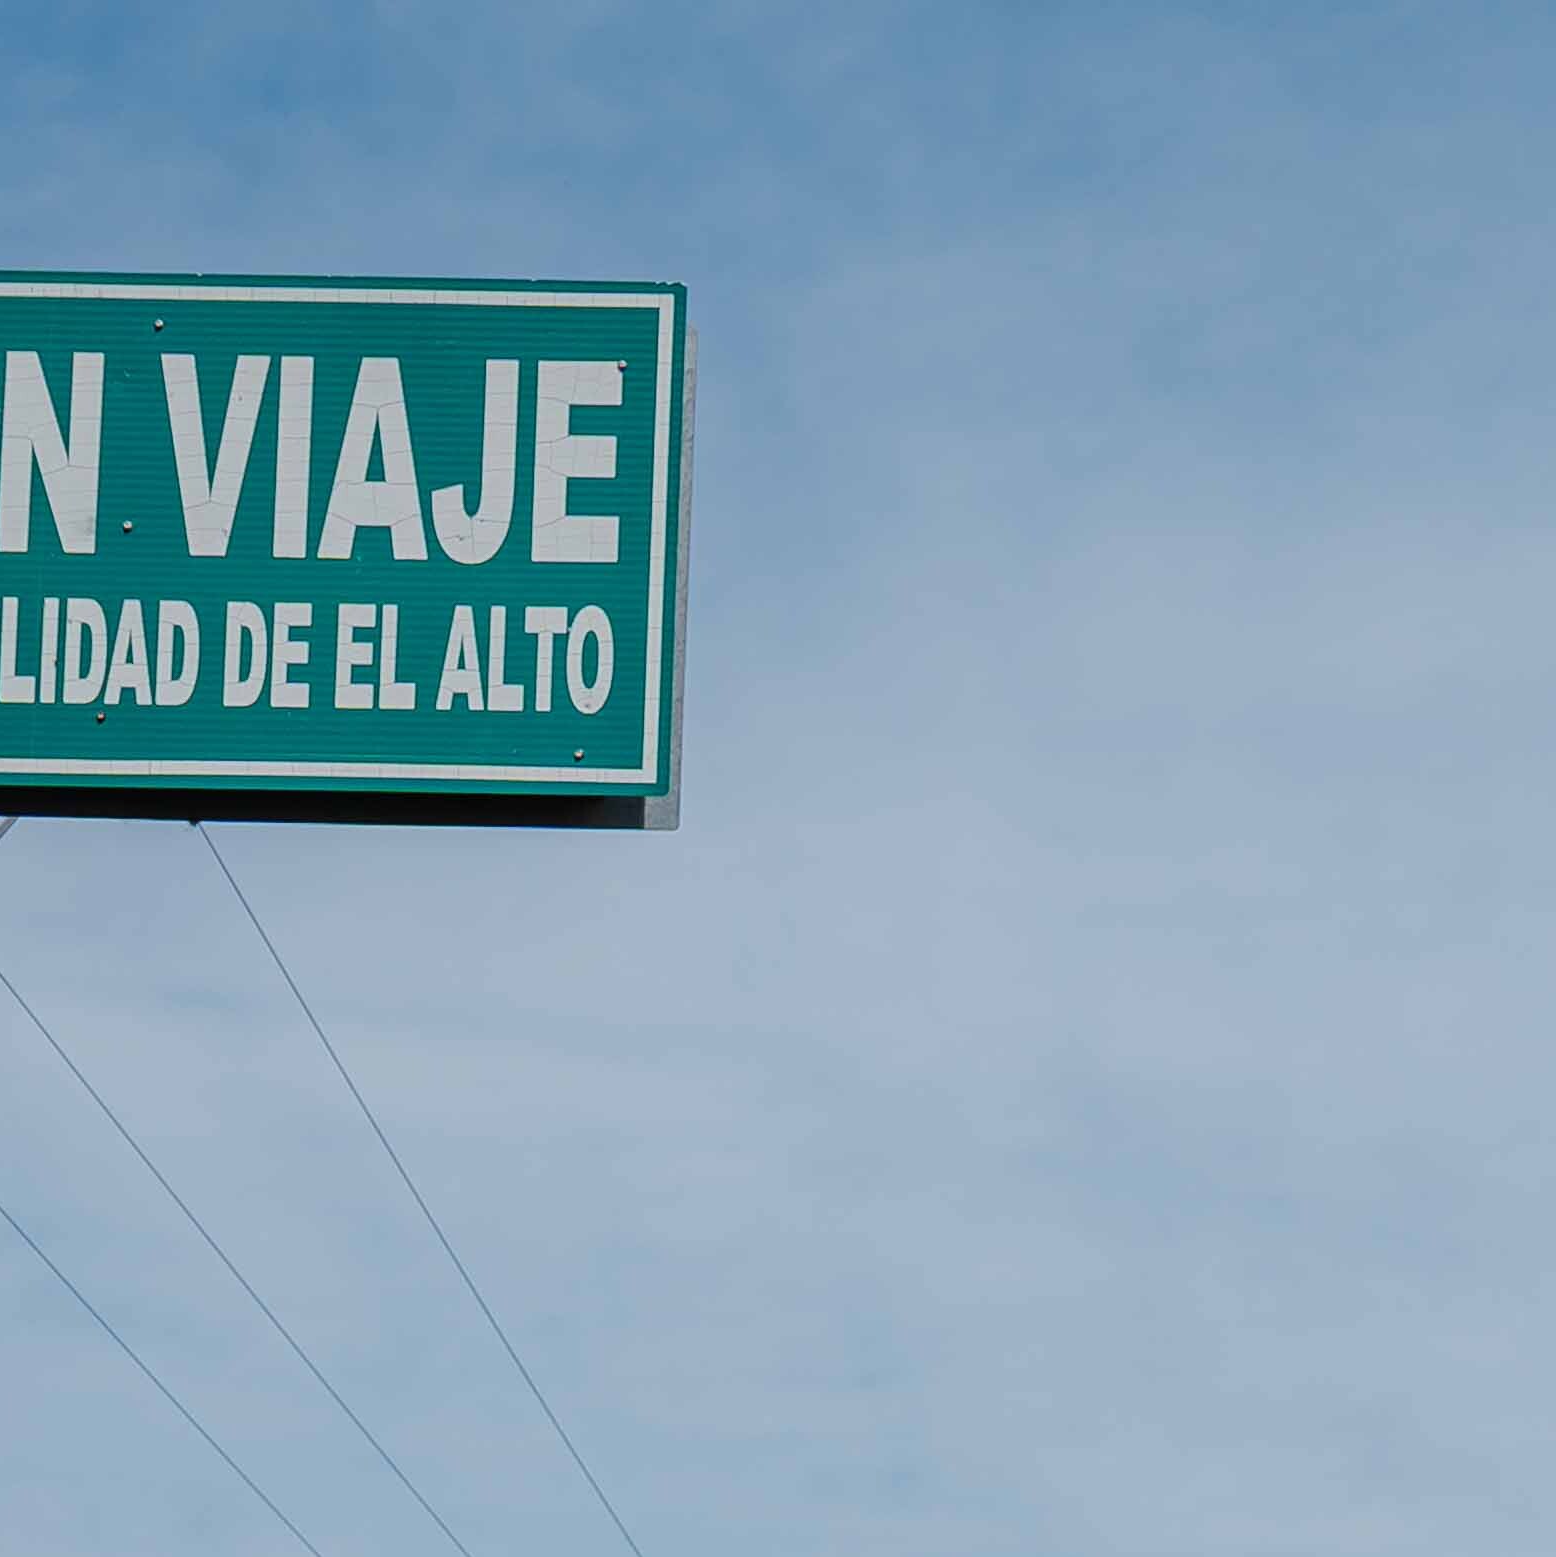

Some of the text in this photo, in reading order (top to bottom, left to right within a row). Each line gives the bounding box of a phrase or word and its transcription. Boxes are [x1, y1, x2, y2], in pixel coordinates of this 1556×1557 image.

[161, 353, 623, 565] VIAJE
[223, 601, 313, 708] DE
[334, 603, 416, 710] EL
[435, 605, 614, 714] ALTO
